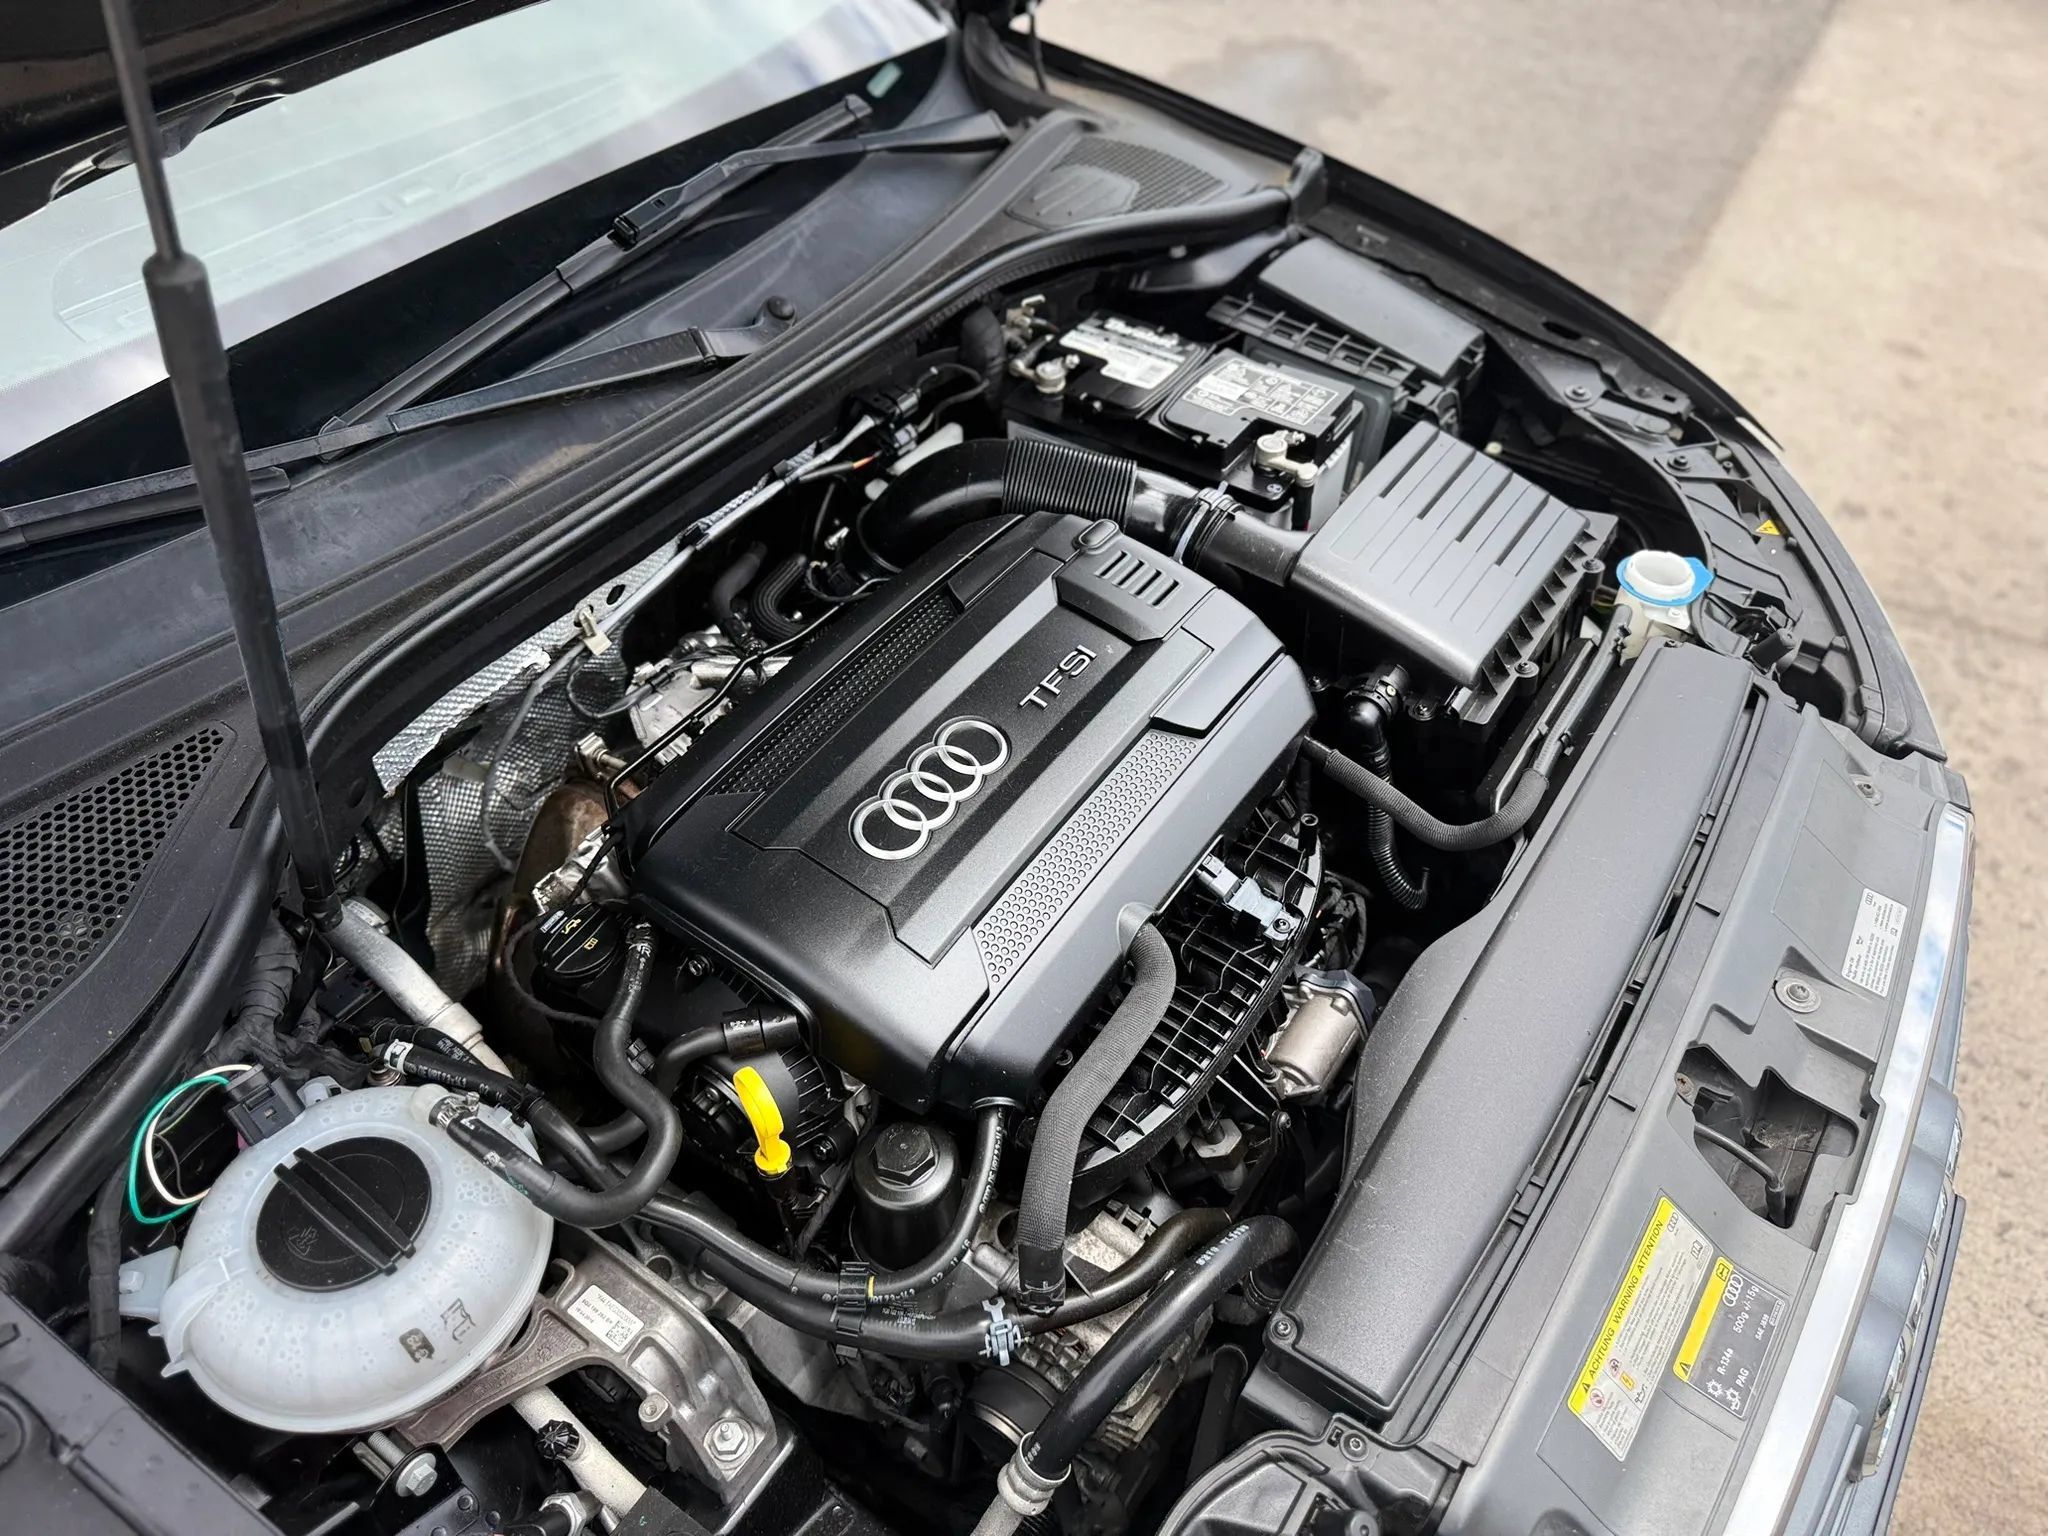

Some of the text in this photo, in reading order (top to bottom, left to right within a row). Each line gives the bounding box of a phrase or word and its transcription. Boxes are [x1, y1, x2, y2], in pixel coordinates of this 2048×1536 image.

[1019, 644, 1097, 709] TFSI
[1588, 1328, 1615, 1379] ACHTUNG
[1613, 1276, 1639, 1324] WARNING
[1637, 1220, 1664, 1274] ATTENTION
[1716, 1347, 1734, 1375] R-134a
[1733, 1311, 1749, 1334] 500g
[1735, 1367, 1749, 1388] PAG
